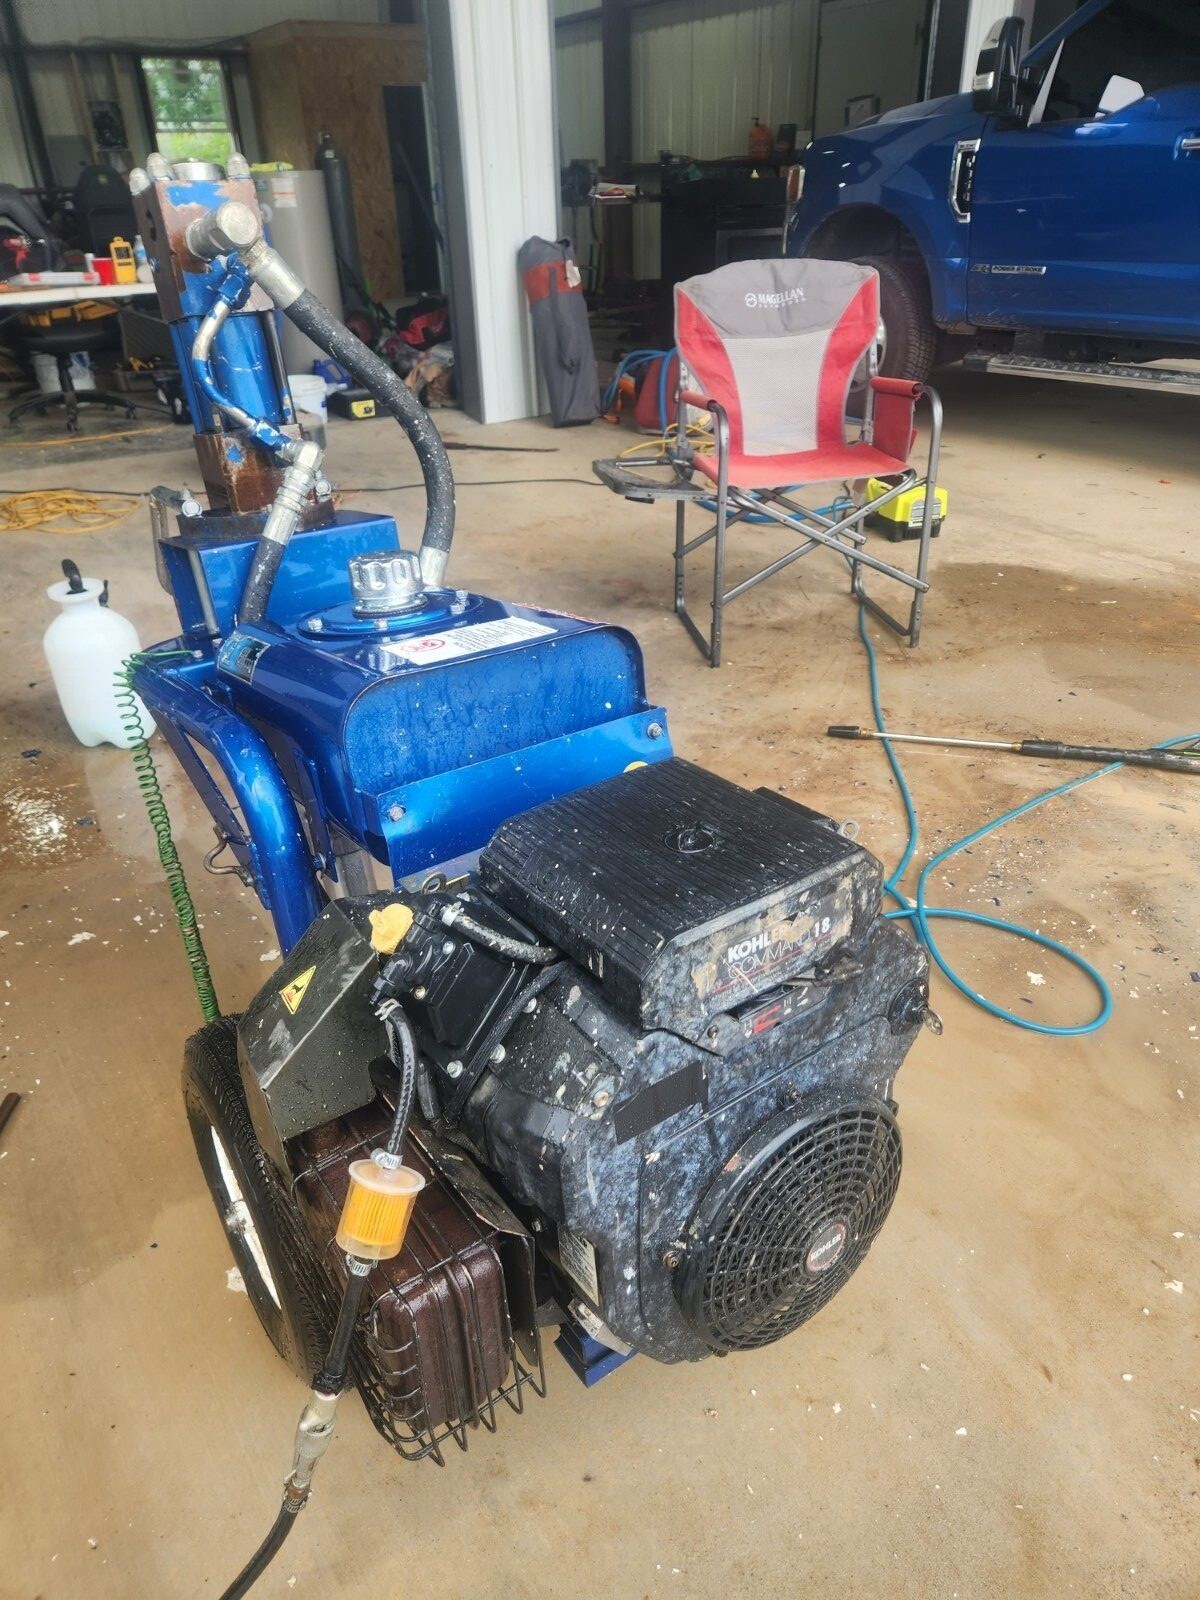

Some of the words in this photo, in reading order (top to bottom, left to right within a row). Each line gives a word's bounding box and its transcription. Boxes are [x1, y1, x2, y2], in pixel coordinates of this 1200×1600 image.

[758, 287, 804, 304] MAGELLAN
[814, 916, 831, 938] 18
[811, 1233, 842, 1262] KOHLER
